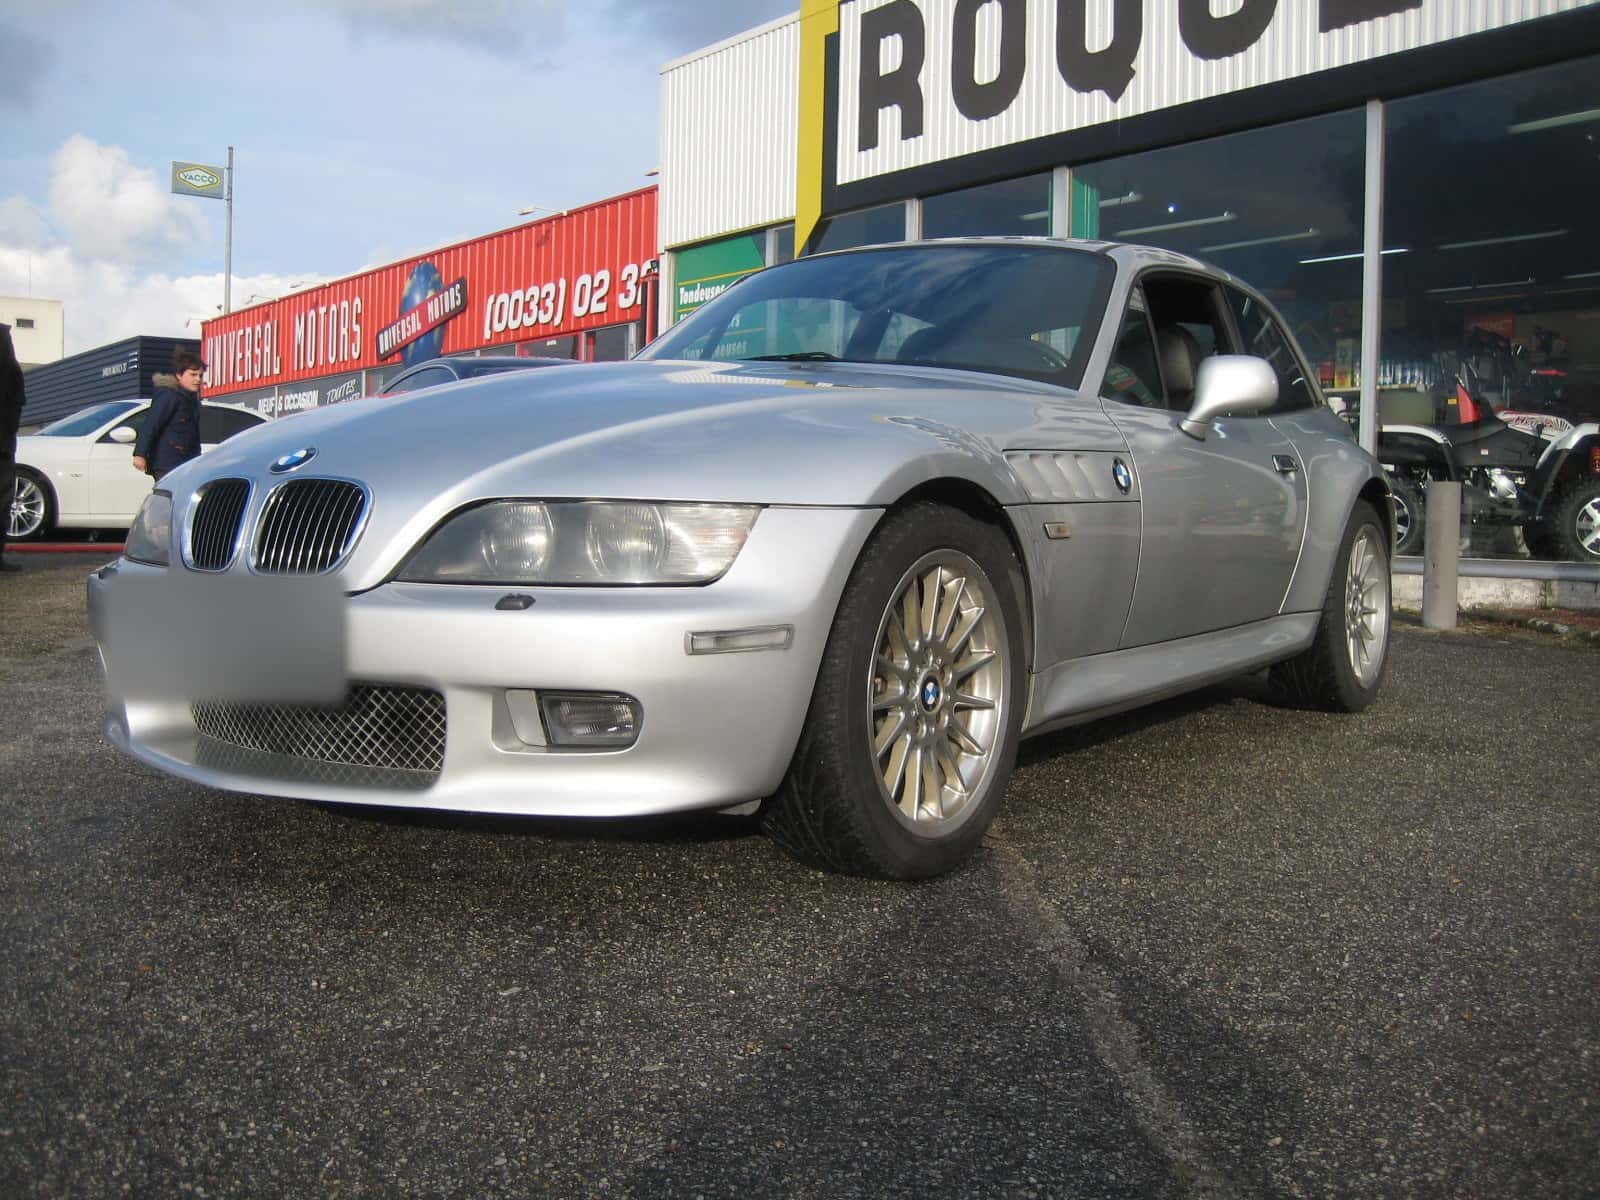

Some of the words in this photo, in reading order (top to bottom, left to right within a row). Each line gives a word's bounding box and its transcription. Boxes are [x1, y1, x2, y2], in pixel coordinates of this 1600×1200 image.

[858, 0, 1422, 152] ROQ
[183, 173, 214, 183] YACCO
[378, 309, 422, 355] UNIVERSAL
[427, 283, 461, 324] MOTORS
[484, 277, 566, 340] (0033)
[573, 269, 610, 317] 02
[205, 319, 281, 388] UNIVERSAL
[294, 296, 362, 371] MOTORS
[284, 390, 319, 410] OCCASION
